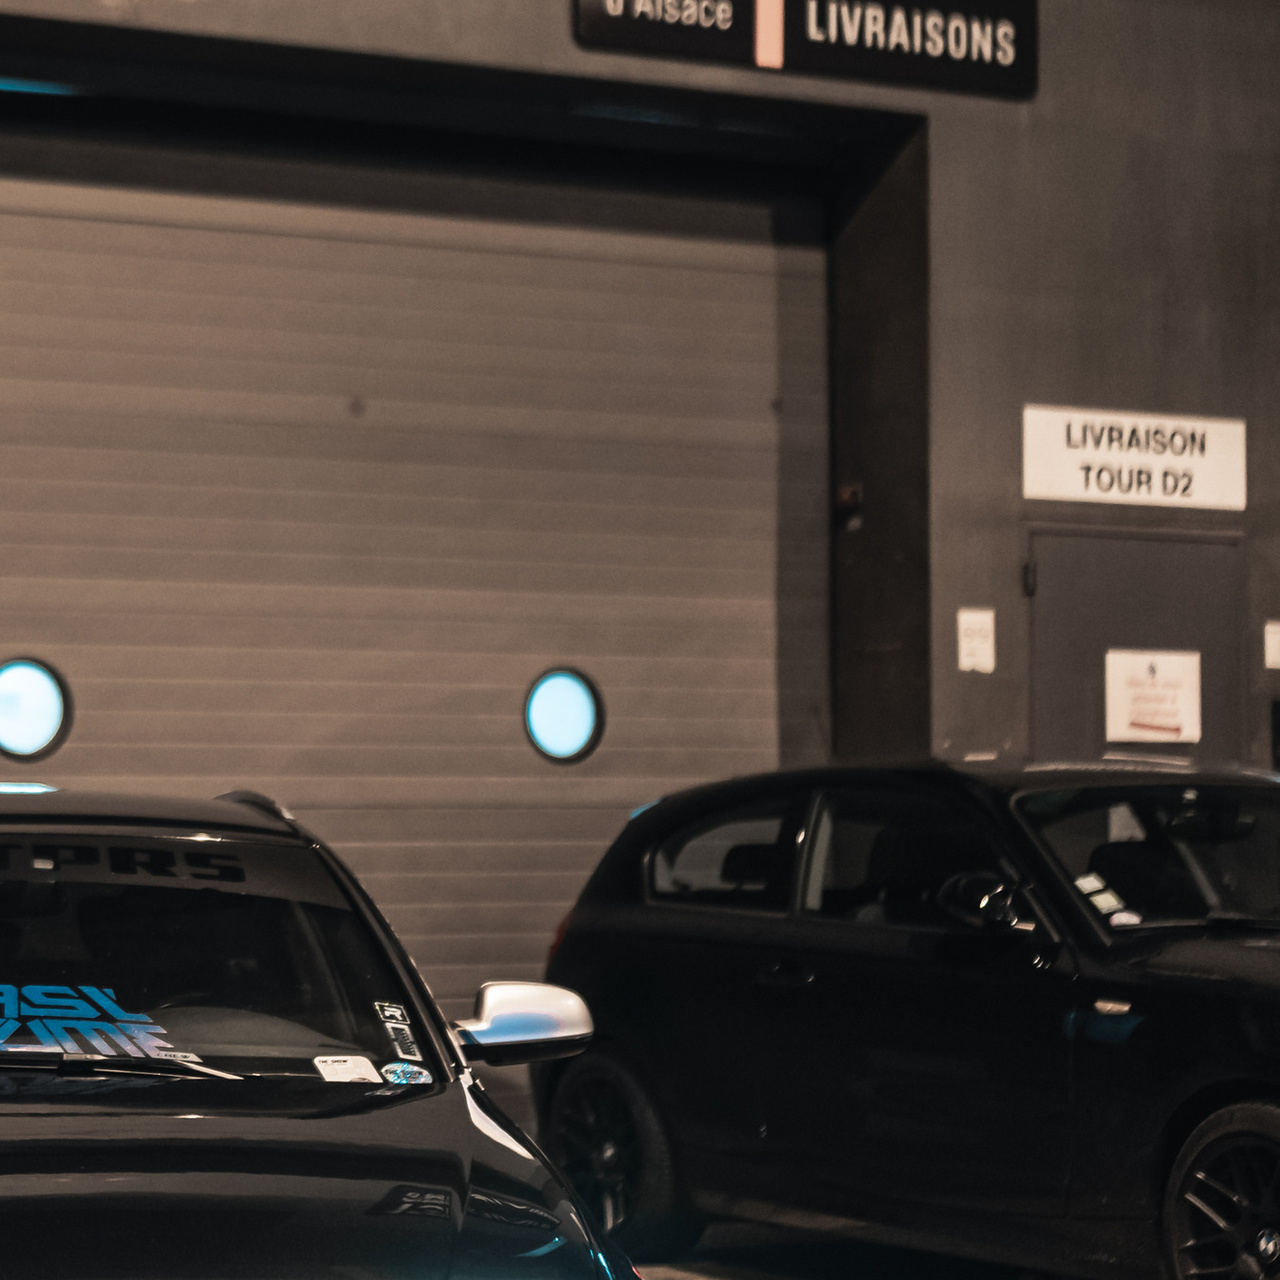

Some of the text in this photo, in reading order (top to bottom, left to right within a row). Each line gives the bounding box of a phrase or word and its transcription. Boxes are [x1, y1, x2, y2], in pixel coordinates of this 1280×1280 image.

[1065, 422, 1207, 458] LIVRAISON
[1079, 463, 1194, 498] TOUR D2
